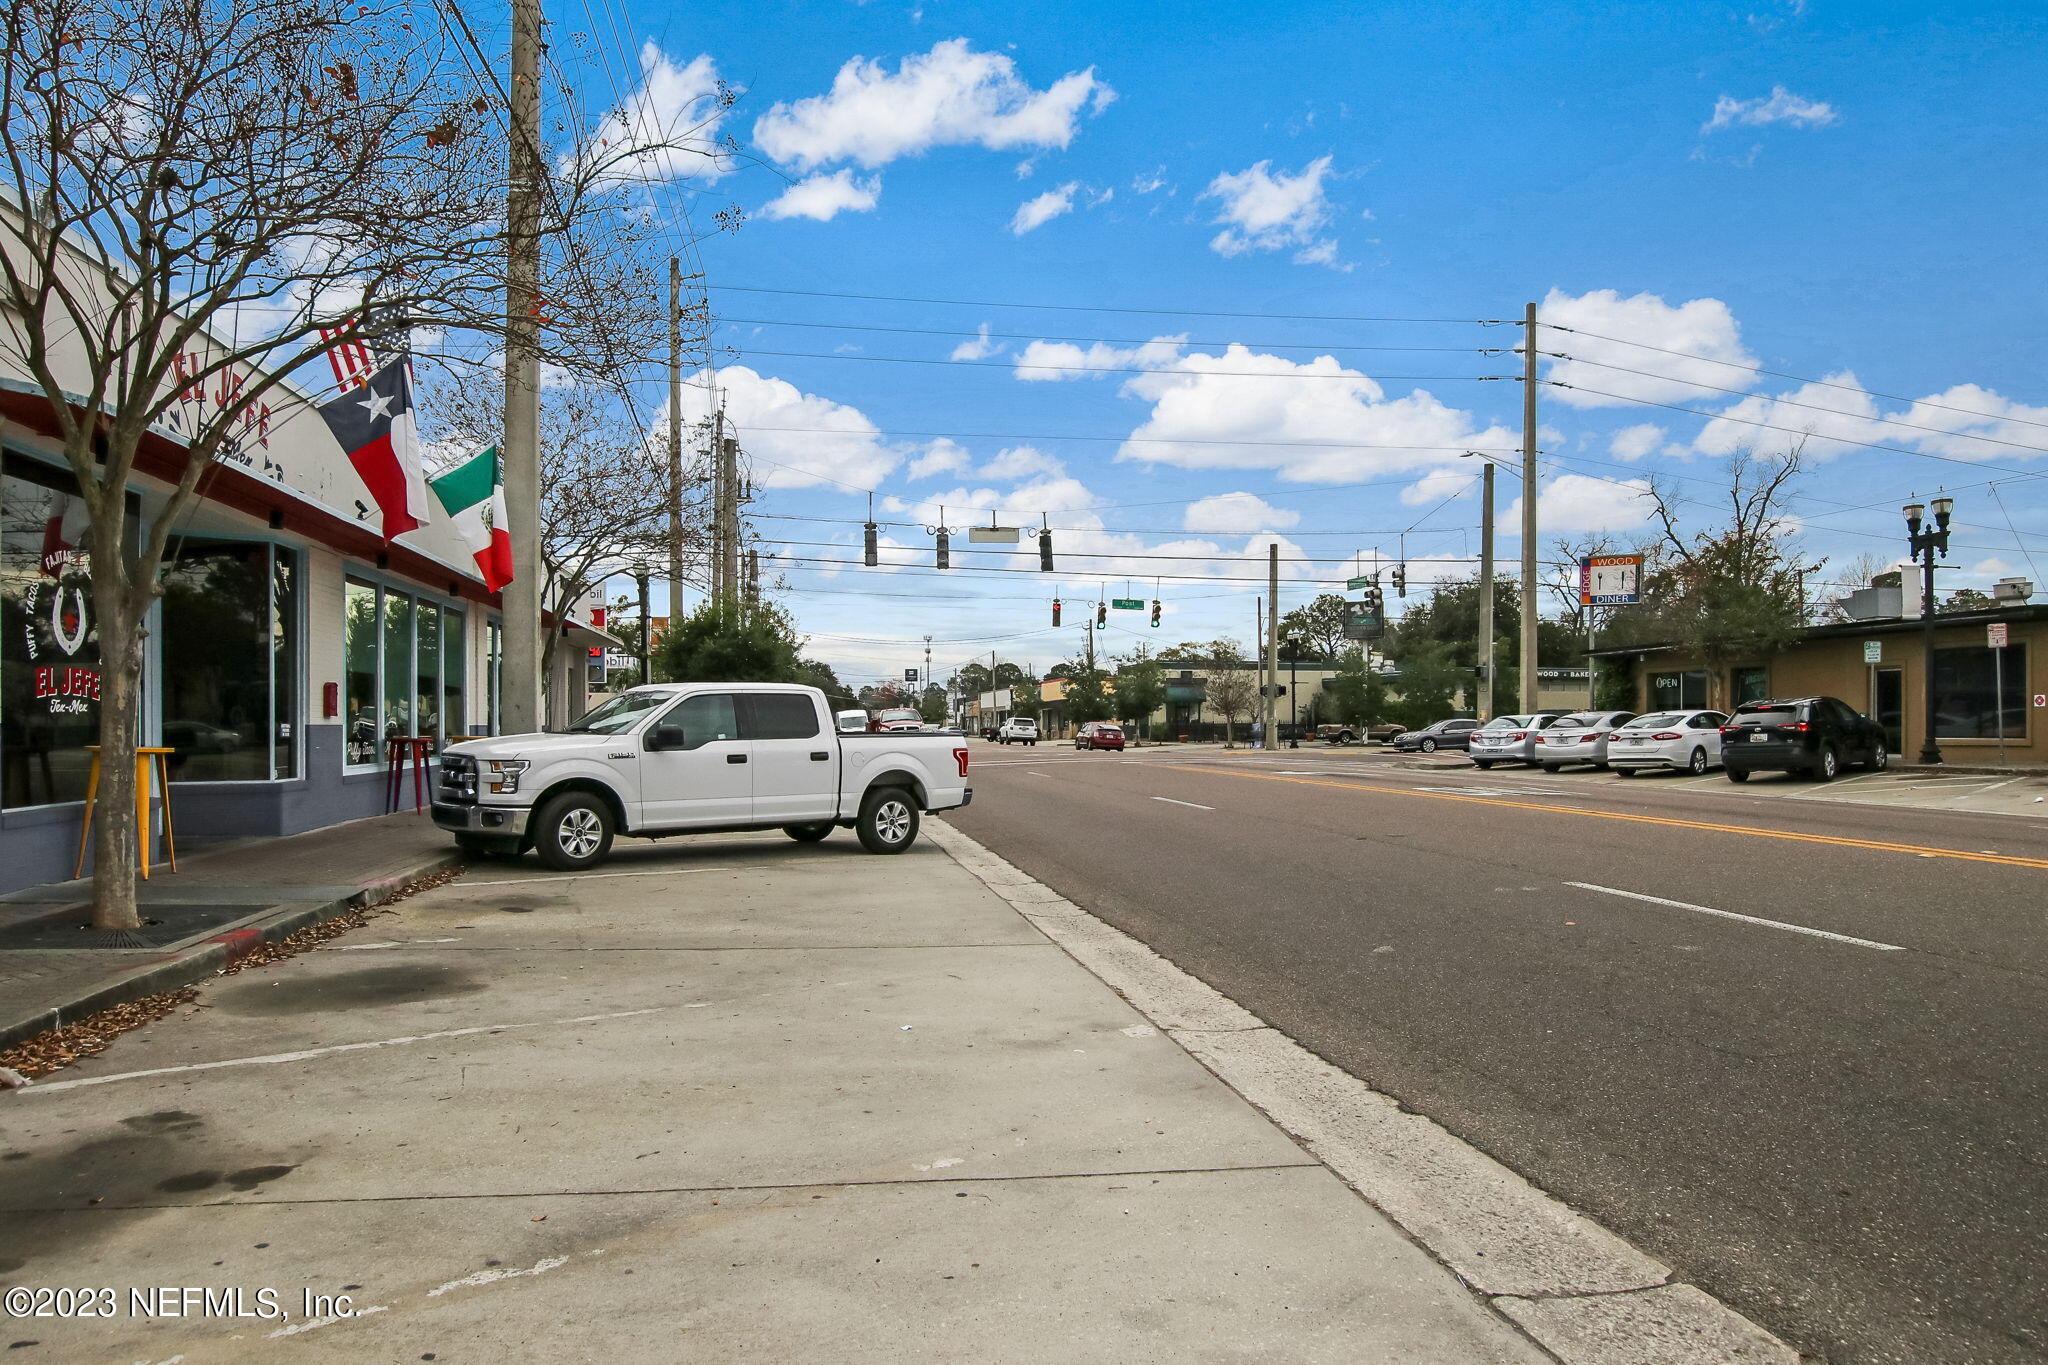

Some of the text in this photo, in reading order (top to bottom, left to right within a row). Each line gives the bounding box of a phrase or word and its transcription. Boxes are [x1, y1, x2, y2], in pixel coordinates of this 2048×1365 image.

[172, 352, 206, 405] EL
[1597, 557, 1634, 566] WOOD
[1582, 570, 1591, 593] EDGE
[590, 589, 602, 599] bil
[1596, 594, 1629, 603] DINER
[26, 582, 40, 660] PUFFY TACOS
[35, 666, 101, 702] EL JEFE
[1656, 677, 1678, 689] OPEN
[50, 699, 88, 715] Tex-Mex
